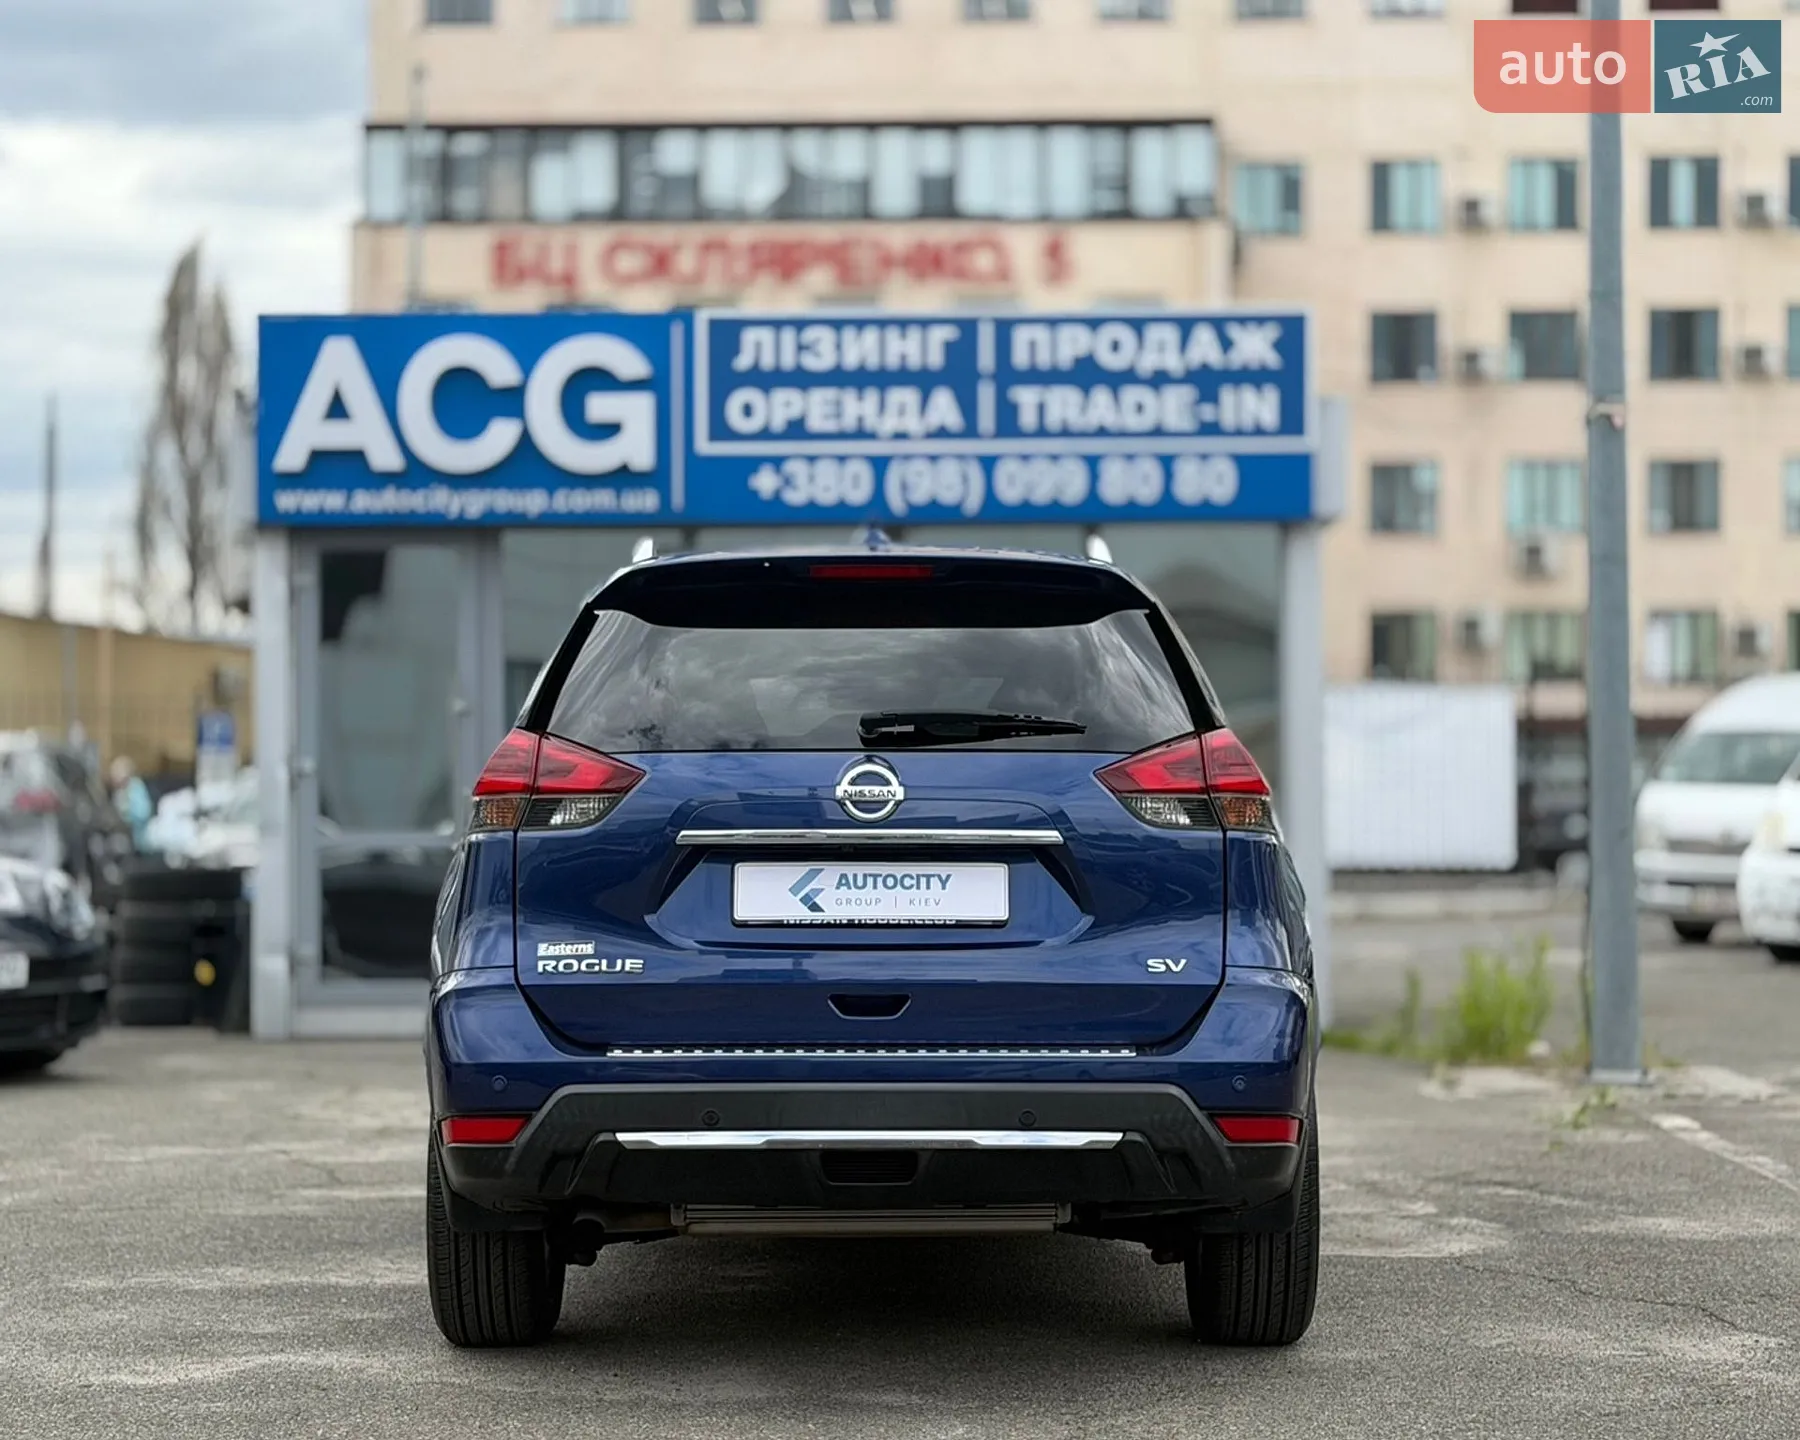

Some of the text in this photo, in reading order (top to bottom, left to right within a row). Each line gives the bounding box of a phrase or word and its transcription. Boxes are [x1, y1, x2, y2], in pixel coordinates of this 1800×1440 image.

[731, 324, 961, 372] ЛІЗИНГ
[1010, 322, 1283, 378] ПРОДАЖ
[271, 332, 658, 476] ACG
[724, 386, 965, 438] ОРЕНДА
[1008, 384, 1281, 433] TRADE-IN
[842, 789, 897, 799] NISSAN
[835, 873, 952, 891] AUTOCITY
[835, 899, 941, 907] GROUP KIEV
[537, 959, 644, 973] ROGUE
[1147, 958, 1187, 972] SV
